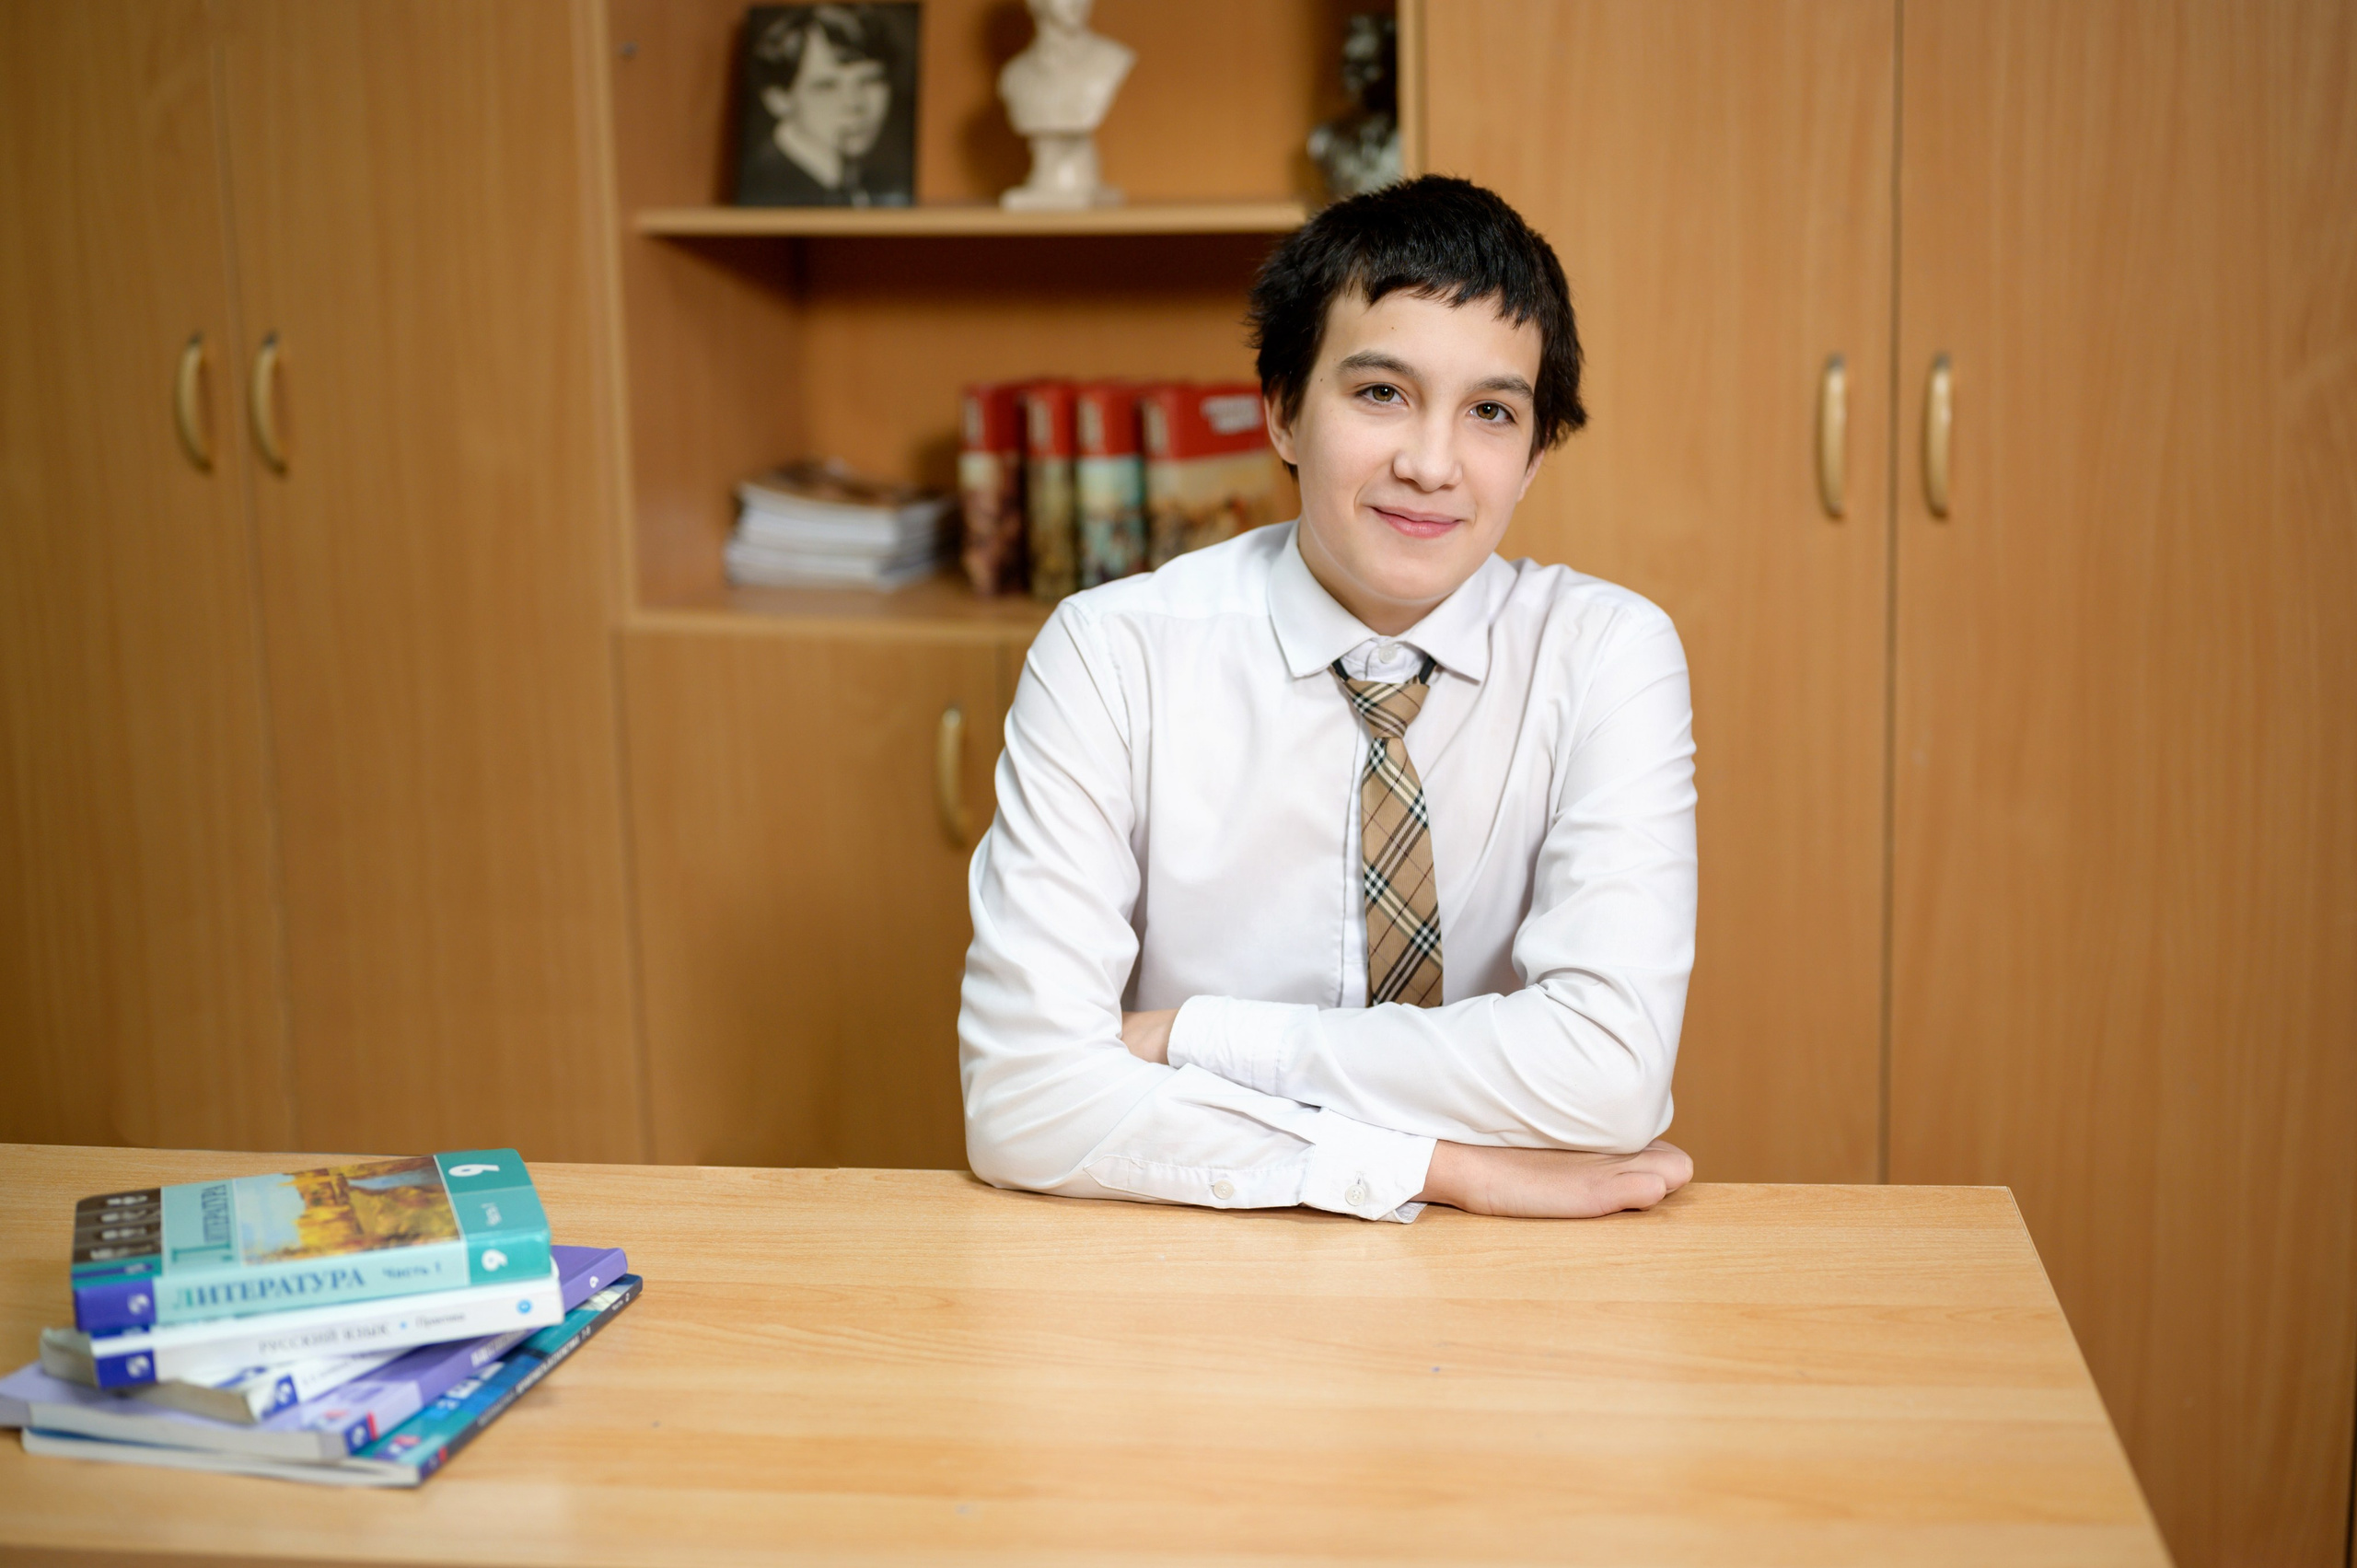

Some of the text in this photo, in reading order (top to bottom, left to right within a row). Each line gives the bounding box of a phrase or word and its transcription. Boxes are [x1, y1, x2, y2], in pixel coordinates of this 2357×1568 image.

[448, 1164, 500, 1177] 9
[173, 1268, 366, 1309] ЛИТЕРАТУРА
[259, 1330, 340, 1354] РУССКИЙ
[344, 1323, 390, 1342] ЯЗЫК
